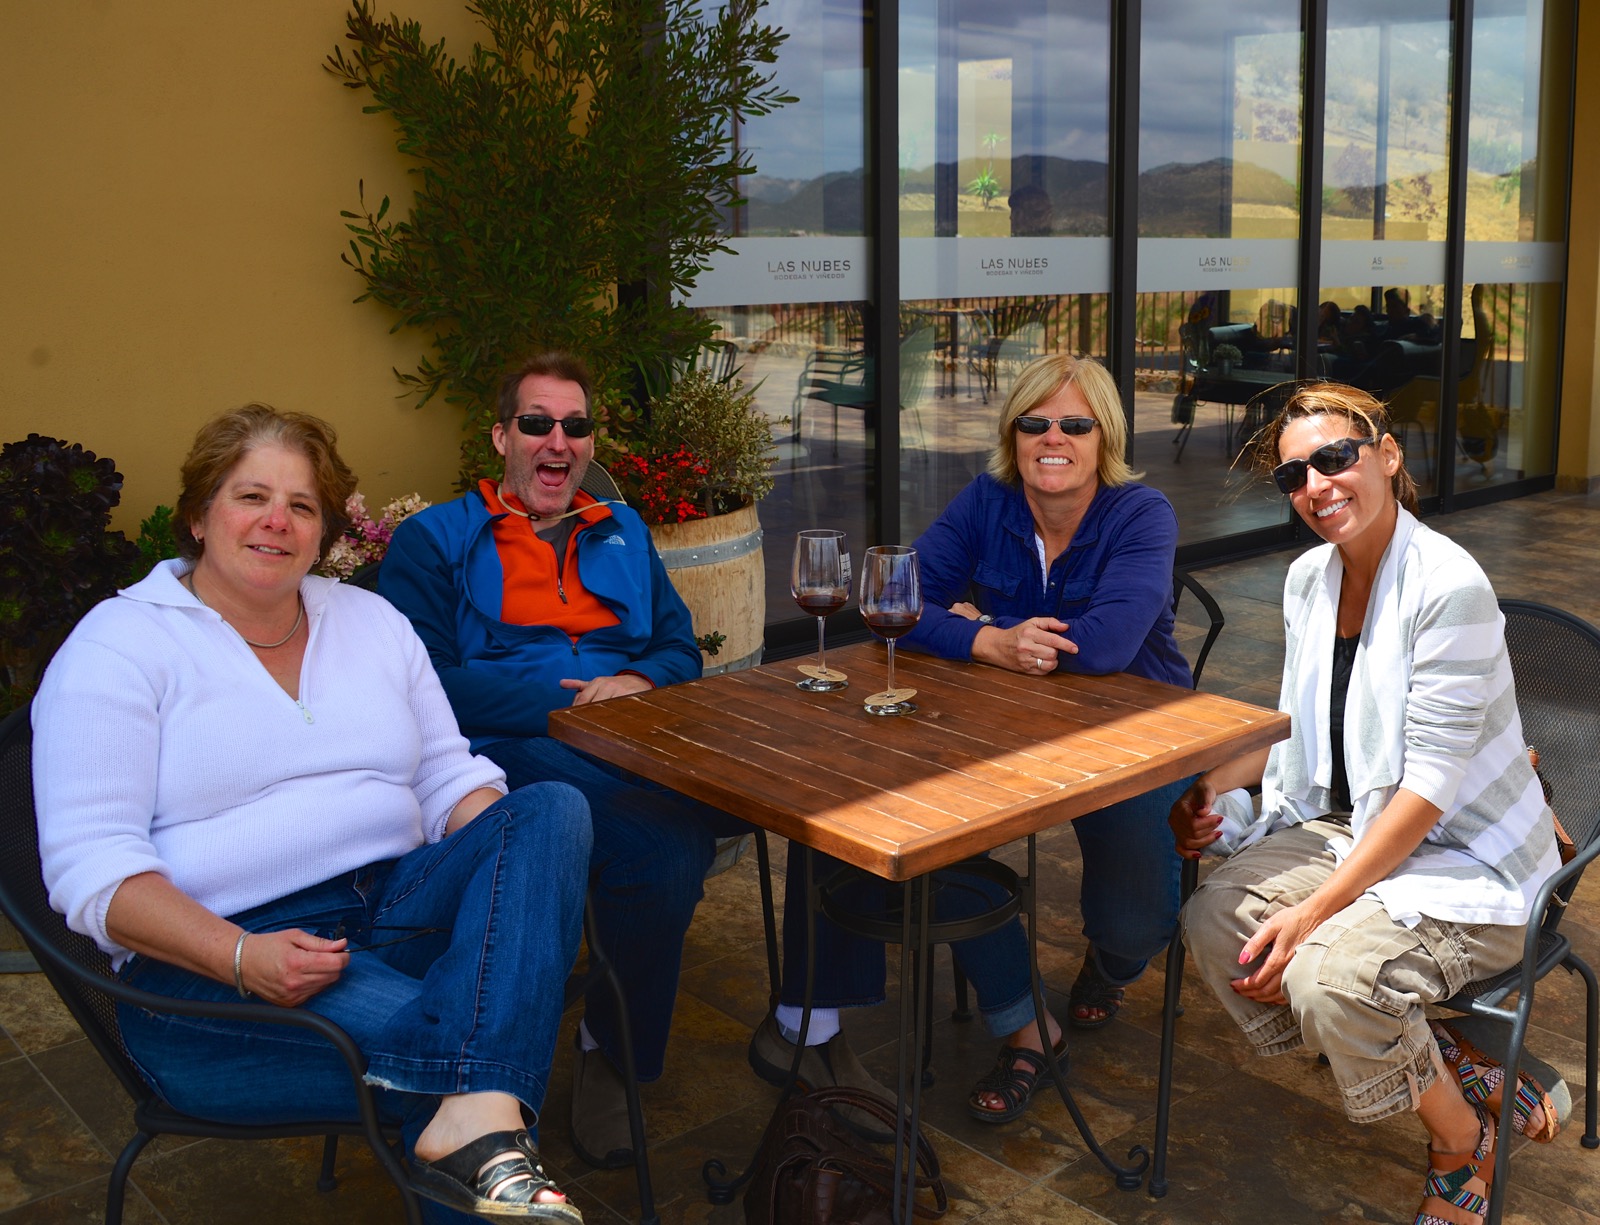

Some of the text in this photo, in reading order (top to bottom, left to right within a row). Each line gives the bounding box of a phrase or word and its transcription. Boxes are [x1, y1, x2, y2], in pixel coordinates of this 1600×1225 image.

[767, 260, 851, 273] LAS NUBES
[981, 257, 1048, 269] LAS NUBES
[1199, 257, 1217, 266] LAS
